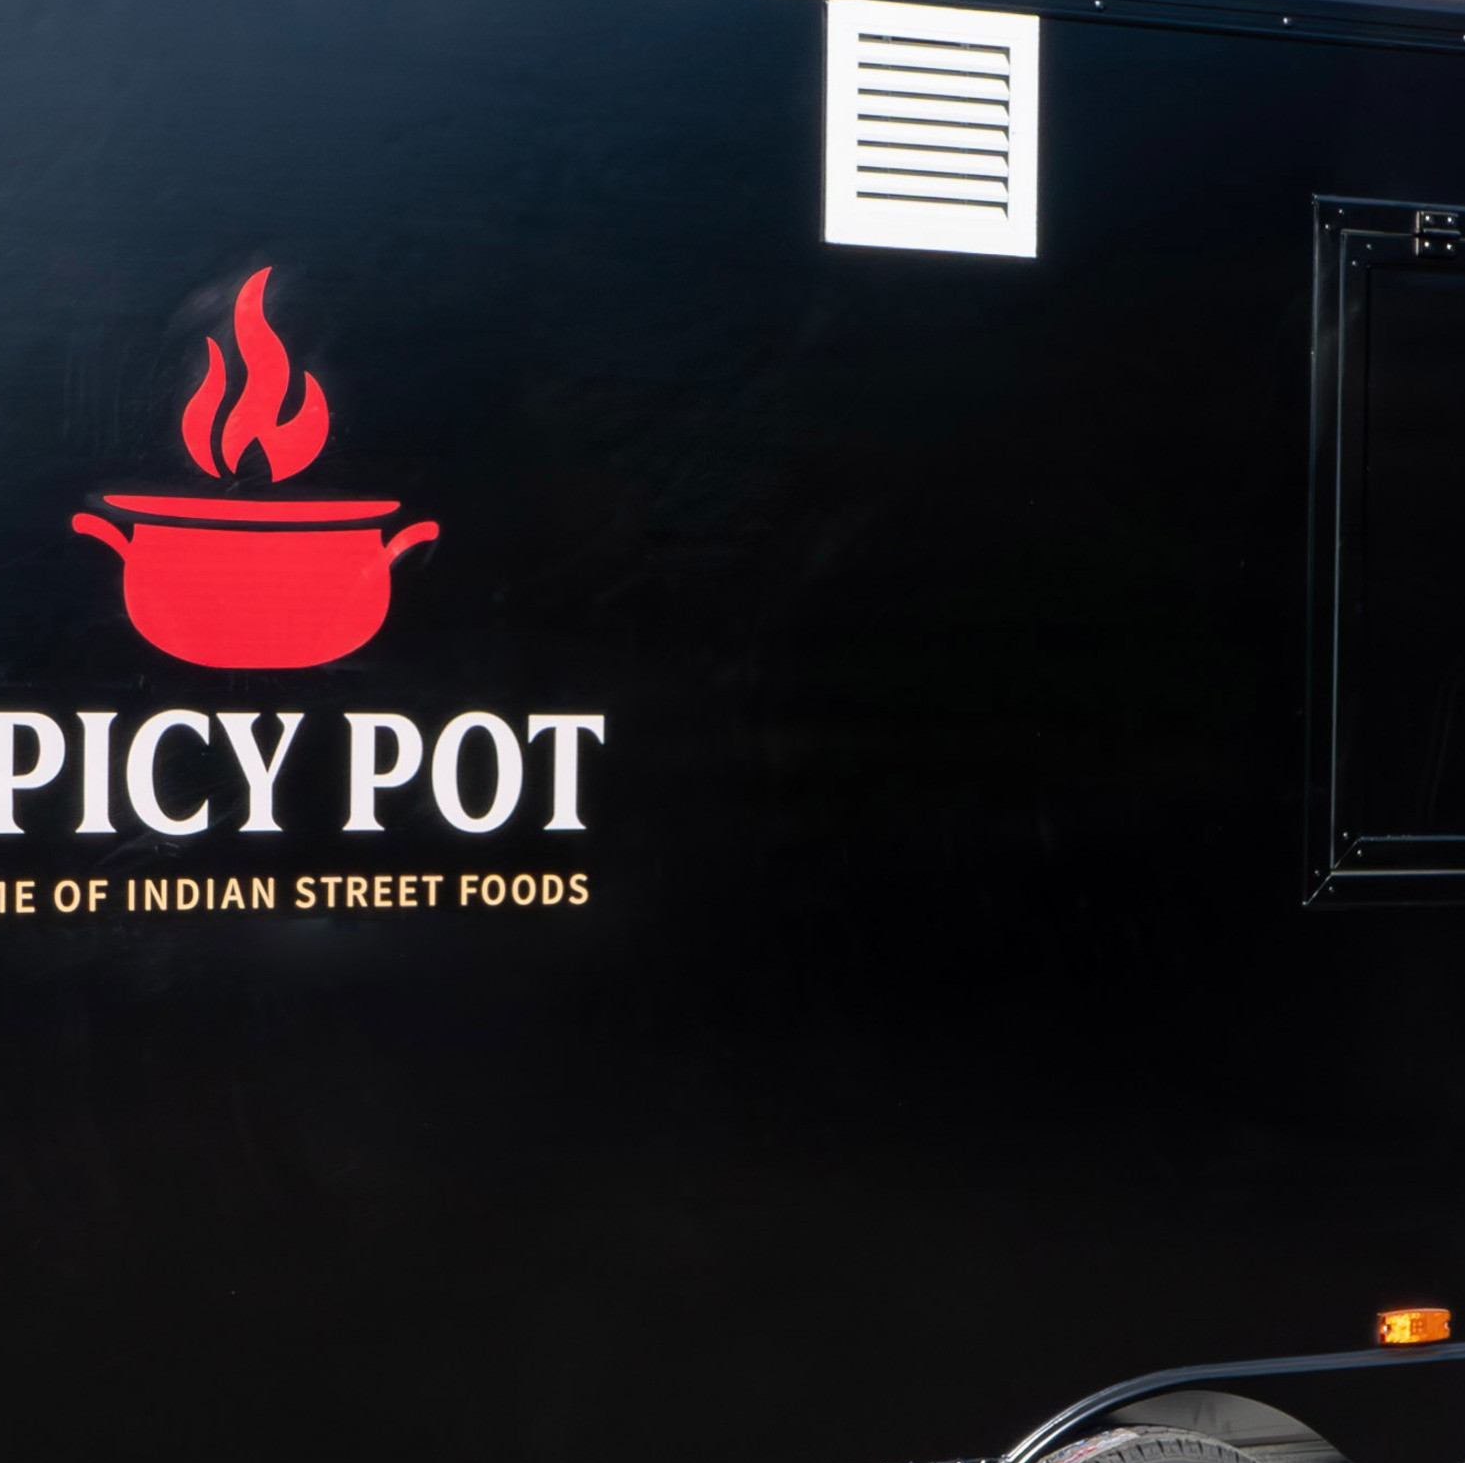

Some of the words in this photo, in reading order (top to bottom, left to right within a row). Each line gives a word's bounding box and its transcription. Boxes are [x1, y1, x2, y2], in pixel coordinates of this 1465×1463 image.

[342, 710, 605, 834] POT
[53, 879, 109, 913] OF
[127, 877, 275, 912] INDIAN
[295, 875, 444, 909] STREET
[460, 873, 589, 906] FOODS
